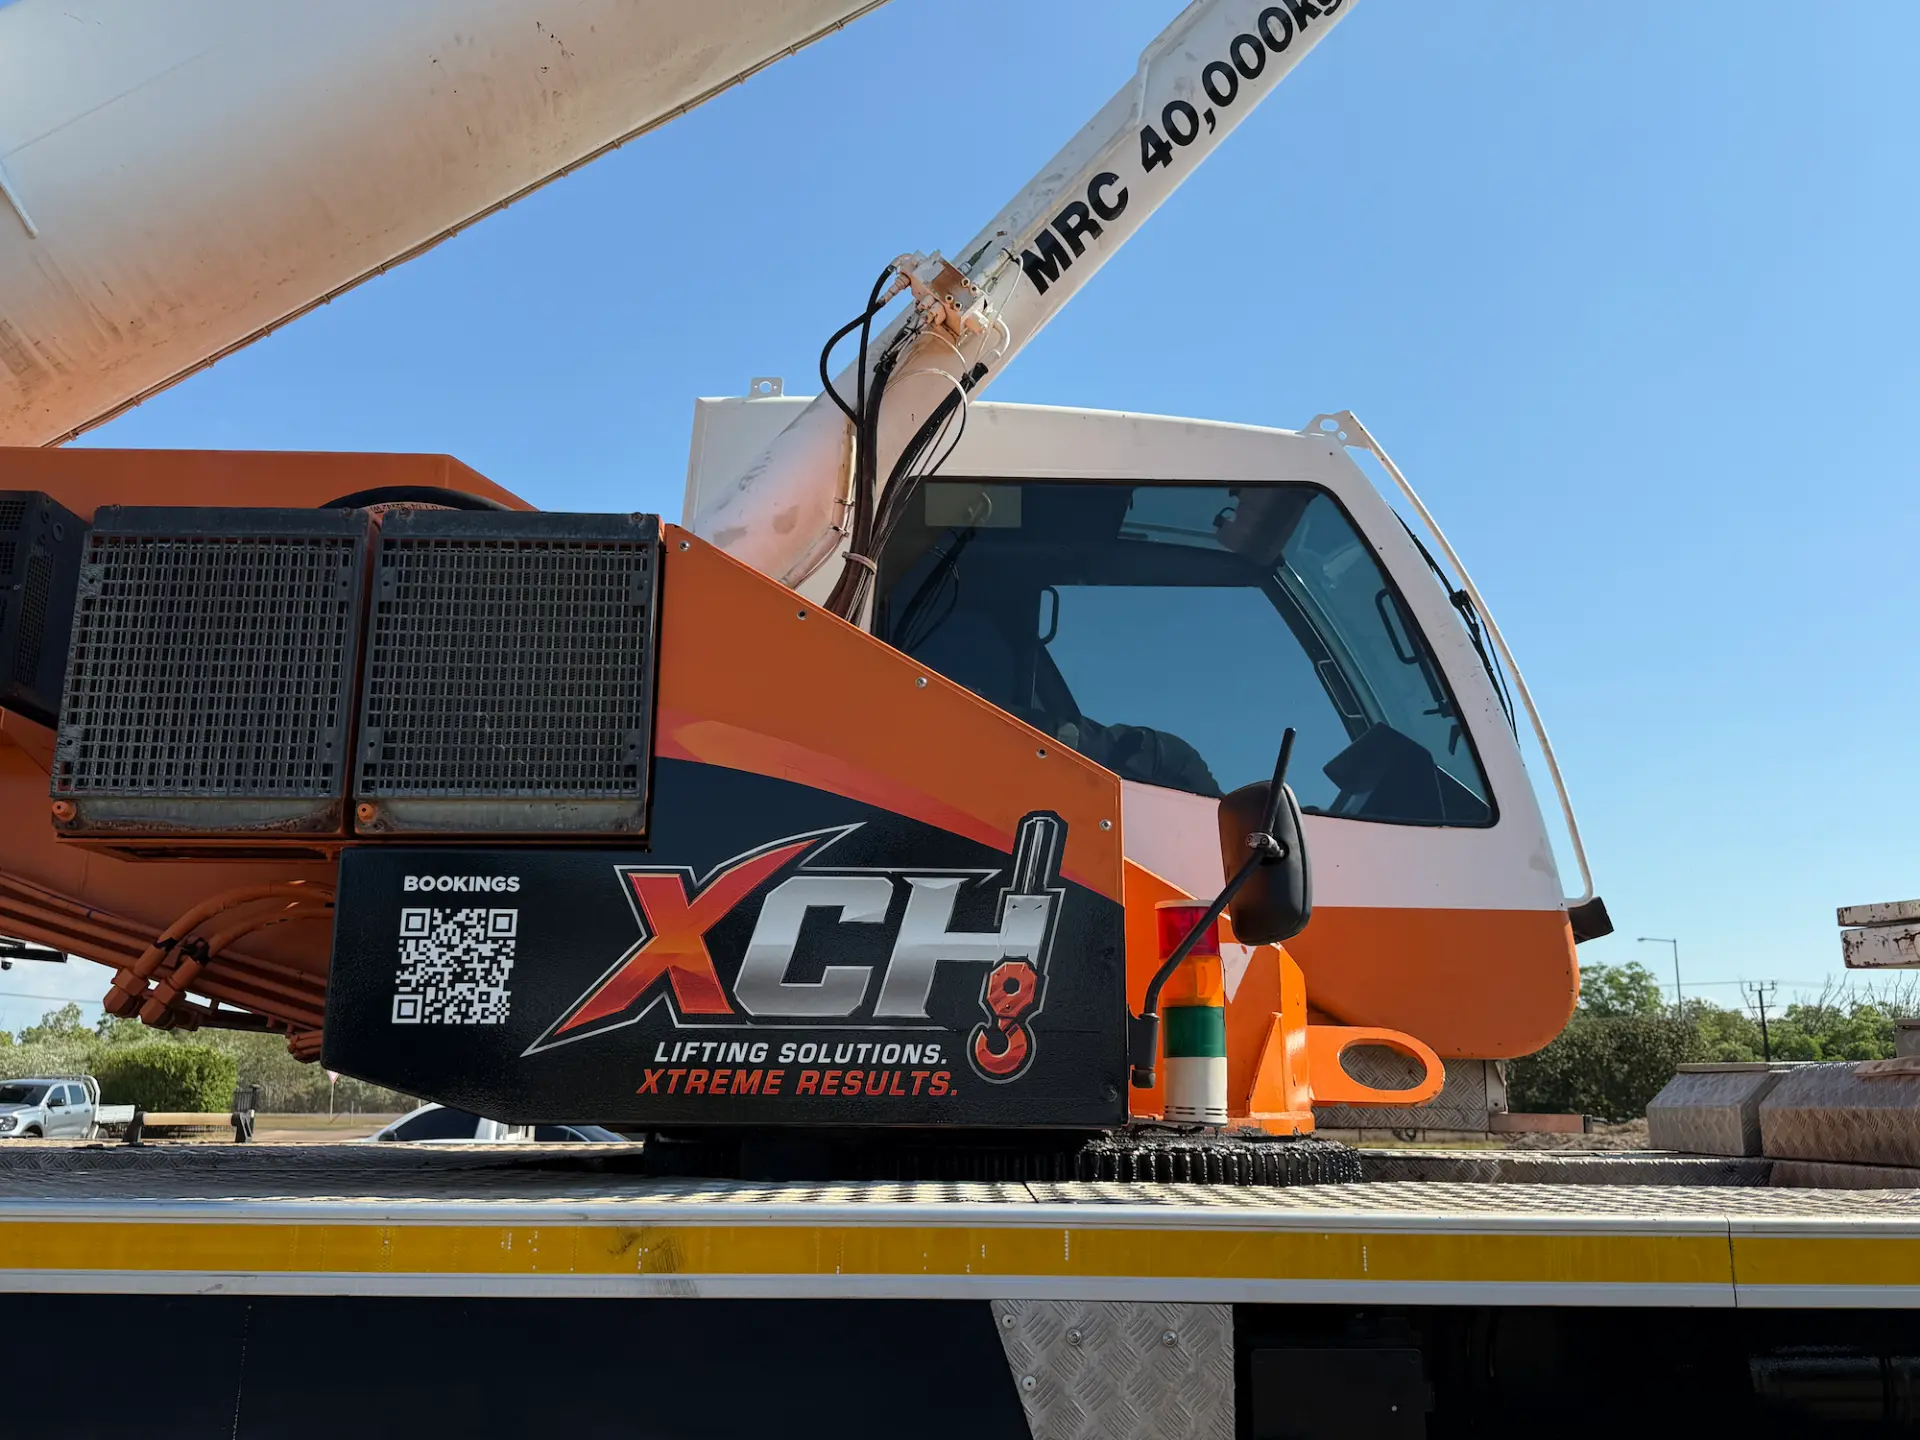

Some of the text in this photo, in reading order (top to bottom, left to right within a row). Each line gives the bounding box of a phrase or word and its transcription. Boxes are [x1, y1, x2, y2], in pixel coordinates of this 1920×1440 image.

[1019, 172, 1129, 296] MRC
[403, 875, 521, 892] BOOKINGS
[530, 826, 1060, 1042] XCH
[654, 1042, 947, 1064] LIFTING SOLUTIONS.
[636, 1068, 958, 1096] XTREME RESULTS.
